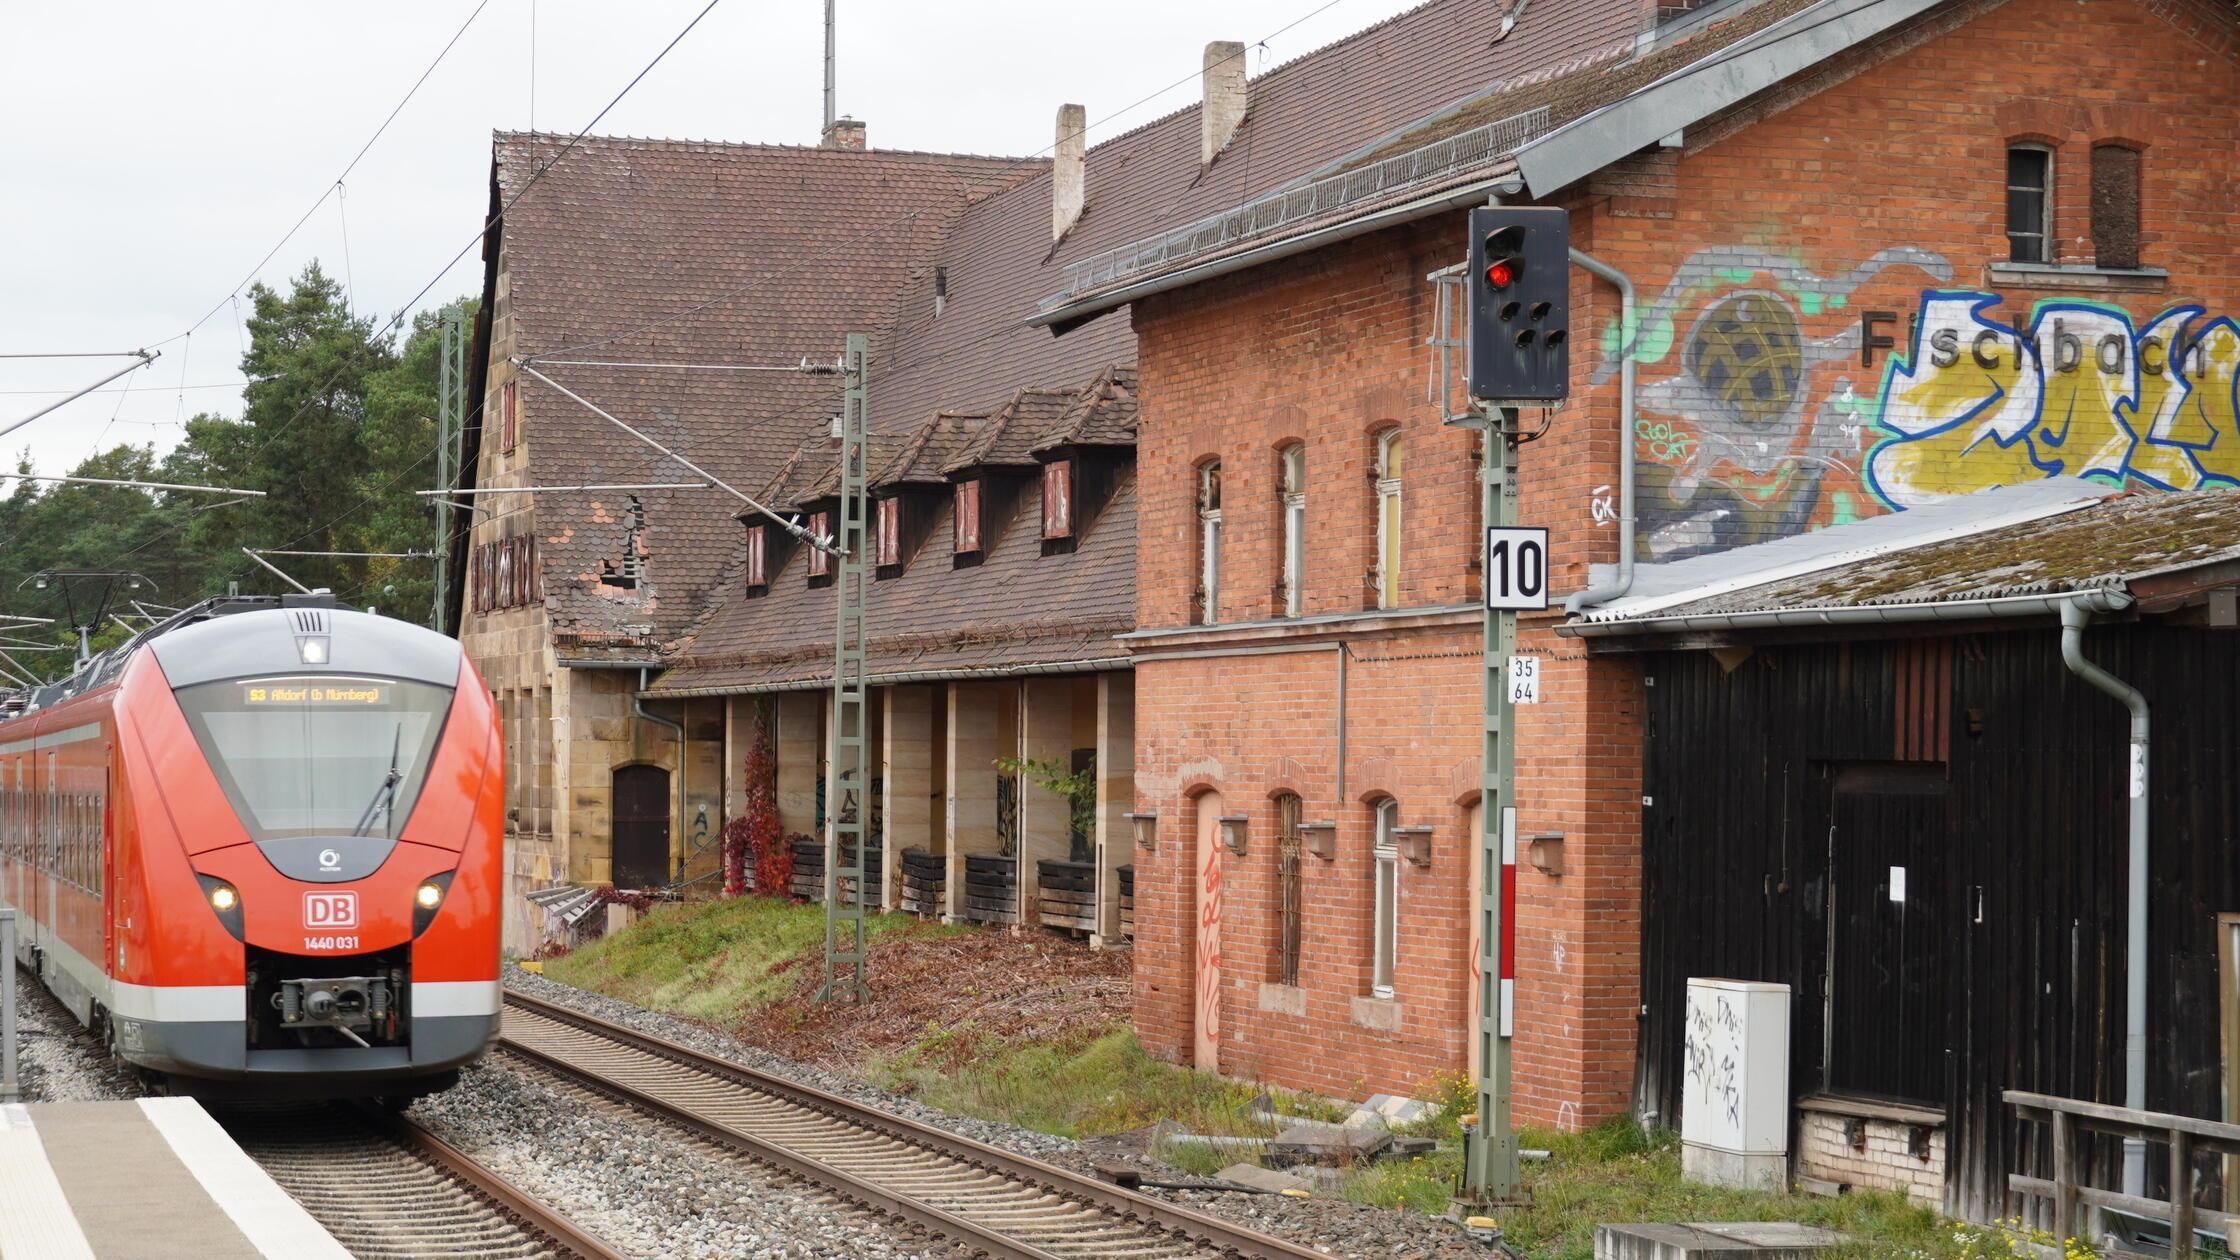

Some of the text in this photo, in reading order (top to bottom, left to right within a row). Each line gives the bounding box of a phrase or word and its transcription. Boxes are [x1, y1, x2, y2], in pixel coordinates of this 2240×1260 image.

[1862, 311, 2205, 378] Fischbach
[1493, 540, 1541, 597] 10
[1515, 660, 1533, 677] 35
[250, 689, 266, 700] S3
[1515, 682, 1533, 699] 64
[312, 898, 350, 922] DB
[304, 936, 359, 949] 1440 031
